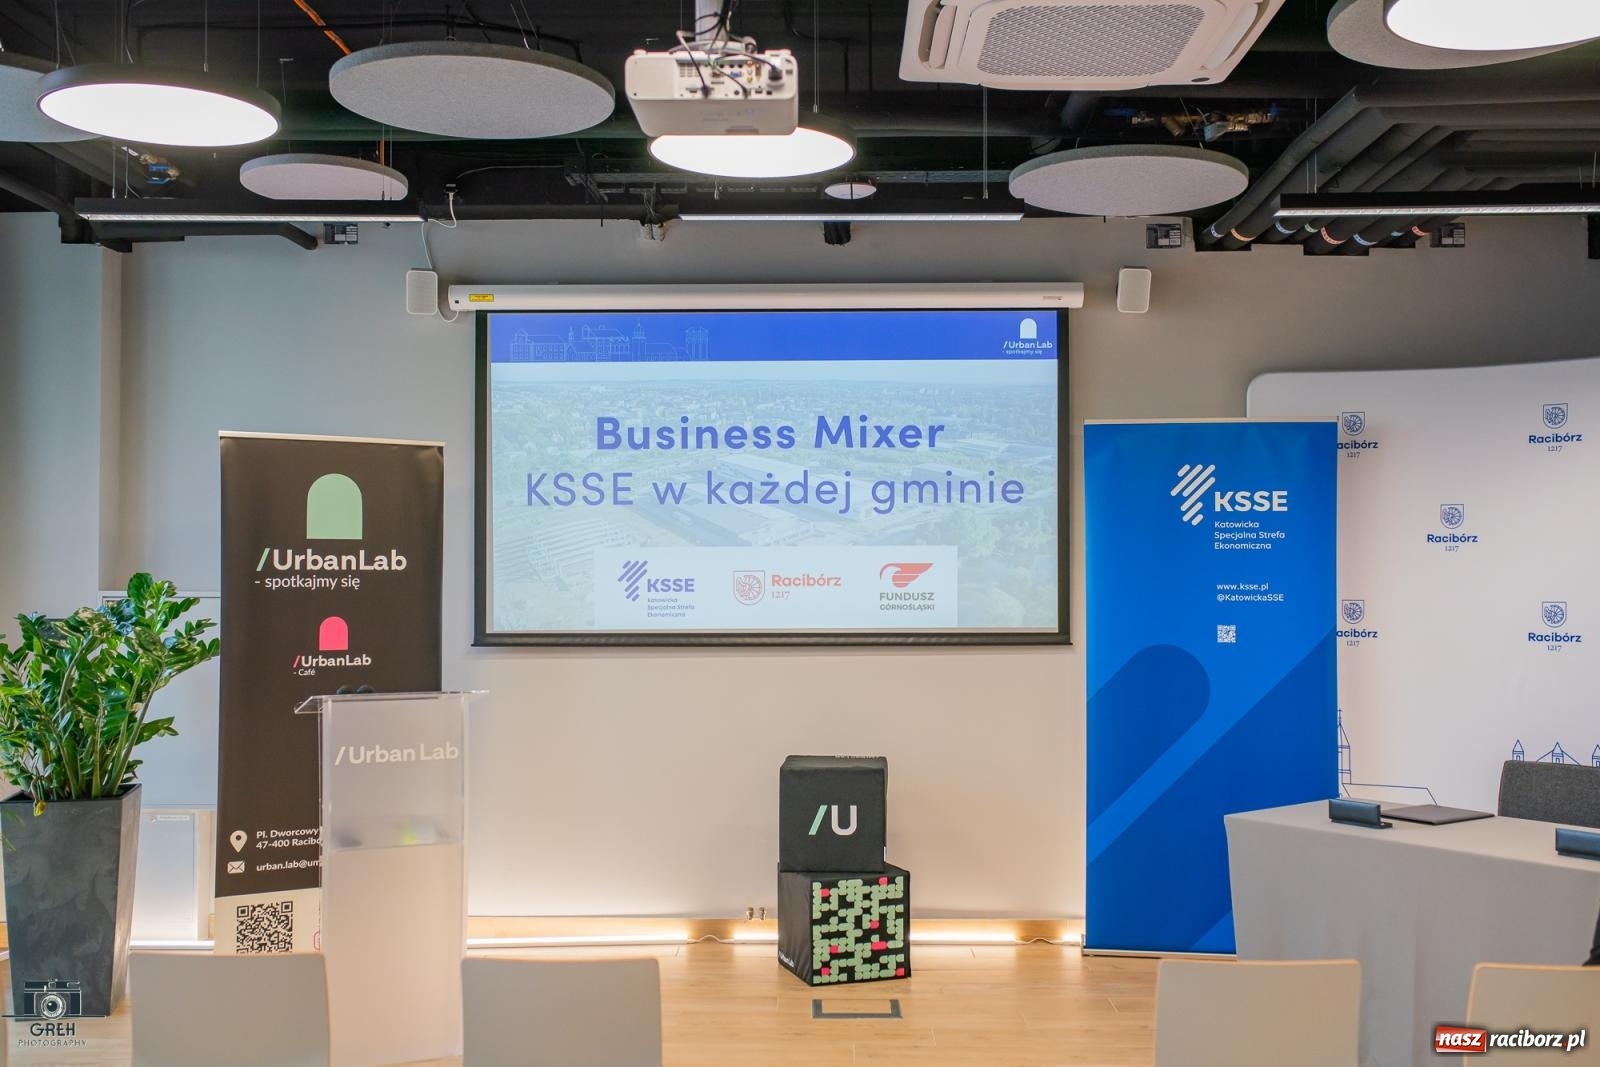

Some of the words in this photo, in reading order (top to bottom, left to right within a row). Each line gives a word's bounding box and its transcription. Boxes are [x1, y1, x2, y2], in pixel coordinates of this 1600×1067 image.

[1036, 340, 1053, 349] Lab
[596, 415, 796, 450] Business
[814, 414, 945, 449] Mixer
[1528, 433, 1582, 444] Racibórz
[1337, 440, 1379, 449] acibórz
[527, 472, 634, 506] KSSE
[652, 482, 687, 504] w
[707, 470, 852, 514] każdej
[871, 470, 1025, 515] gminie
[1214, 490, 1288, 512] KSSE
[1214, 520, 1260, 529] Katowicka
[1214, 531, 1257, 541] Specjalna
[1259, 530, 1286, 539] Strefa
[1426, 533, 1478, 544] Racibórz
[1214, 542, 1272, 550] Ekonomiczna
[256, 547, 407, 572] /UrbanLab
[264, 574, 338, 590] spotkajmy
[340, 574, 360, 590] się
[647, 578, 695, 593] KSSE
[771, 573, 842, 587] Racibórz
[1216, 582, 1269, 591] www.ksse.pl
[879, 592, 935, 601] FUNDUSZ
[1216, 593, 1285, 602] @KatowickaSSE
[1336, 628, 1378, 638] acibórz
[1528, 632, 1582, 643] Racibórz
[292, 654, 372, 668] /UrbanLab
[298, 668, 316, 676] Café
[334, 744, 416, 766] /Urban
[419, 742, 460, 761] Lab
[808, 804, 858, 836] /U
[256, 830, 268, 839] Pl.
[270, 828, 319, 838] Dworcowy
[255, 839, 290, 849] 47-400
